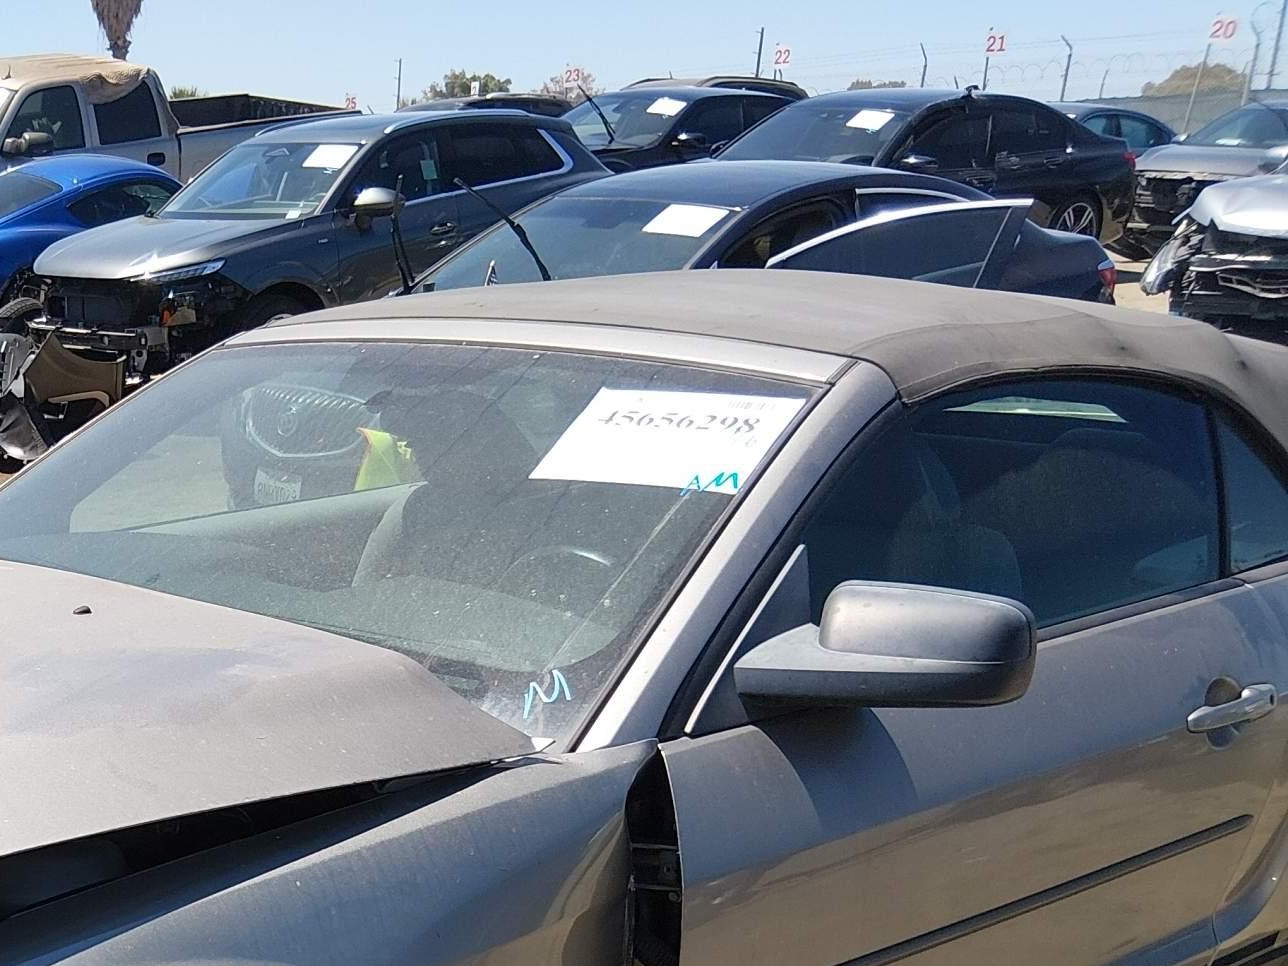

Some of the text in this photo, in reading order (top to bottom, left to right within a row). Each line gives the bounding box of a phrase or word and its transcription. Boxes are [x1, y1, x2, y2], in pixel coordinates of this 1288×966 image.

[1209, 19, 1238, 40] 20
[985, 35, 1006, 53] 21
[774, 49, 791, 65] 22
[564, 68, 581, 83] 23
[345, 97, 357, 110] 25
[598, 410, 760, 434] 45656298
